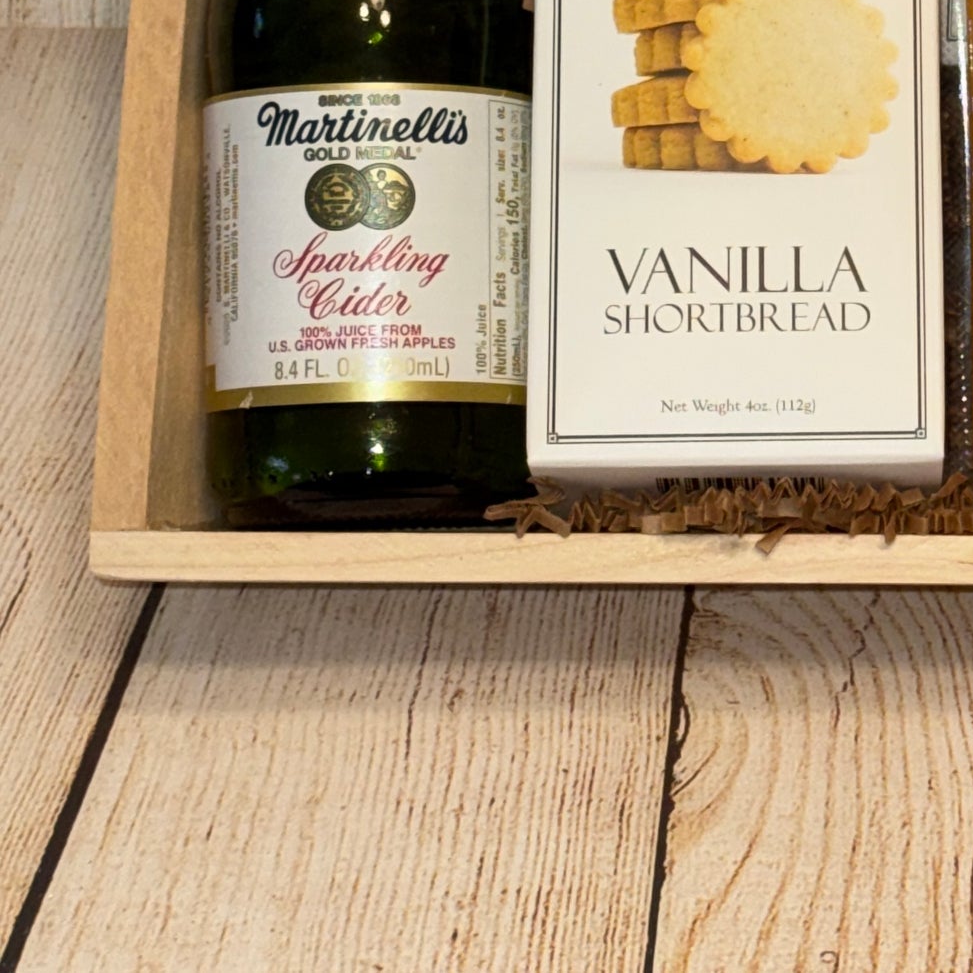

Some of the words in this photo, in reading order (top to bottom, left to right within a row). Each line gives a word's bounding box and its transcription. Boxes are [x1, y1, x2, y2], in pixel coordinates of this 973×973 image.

[257, 101, 469, 146] Martinelli's
[303, 147, 351, 161] GOLD
[506, 196, 520, 226] 150,
[273, 232, 449, 287] Sparkling
[510, 232, 520, 275] Calories
[606, 245, 868, 295] VANILLA
[298, 277, 411, 320] Cider
[493, 272, 507, 307] Facts
[300, 326, 332, 339] 100%
[336, 325, 379, 337] JUICE
[381, 324, 422, 336] FROM
[476, 304, 487, 337] Juice
[603, 301, 871, 335] SHORTBREAD
[268, 340, 292, 353] U.S.
[295, 338, 347, 352] GROWN
[351, 337, 398, 350] FRESH
[402, 337, 456, 349] APPLES
[476, 340, 487, 374] 100%
[493, 319, 507, 375] Nutrition
[275, 360, 298, 380] 8.4
[305, 358, 330, 378] FL.
[660, 400, 687, 414] Net
[692, 399, 741, 416] Weight
[745, 399, 772, 413] 4oz.
[776, 398, 817, 415] (112g)
